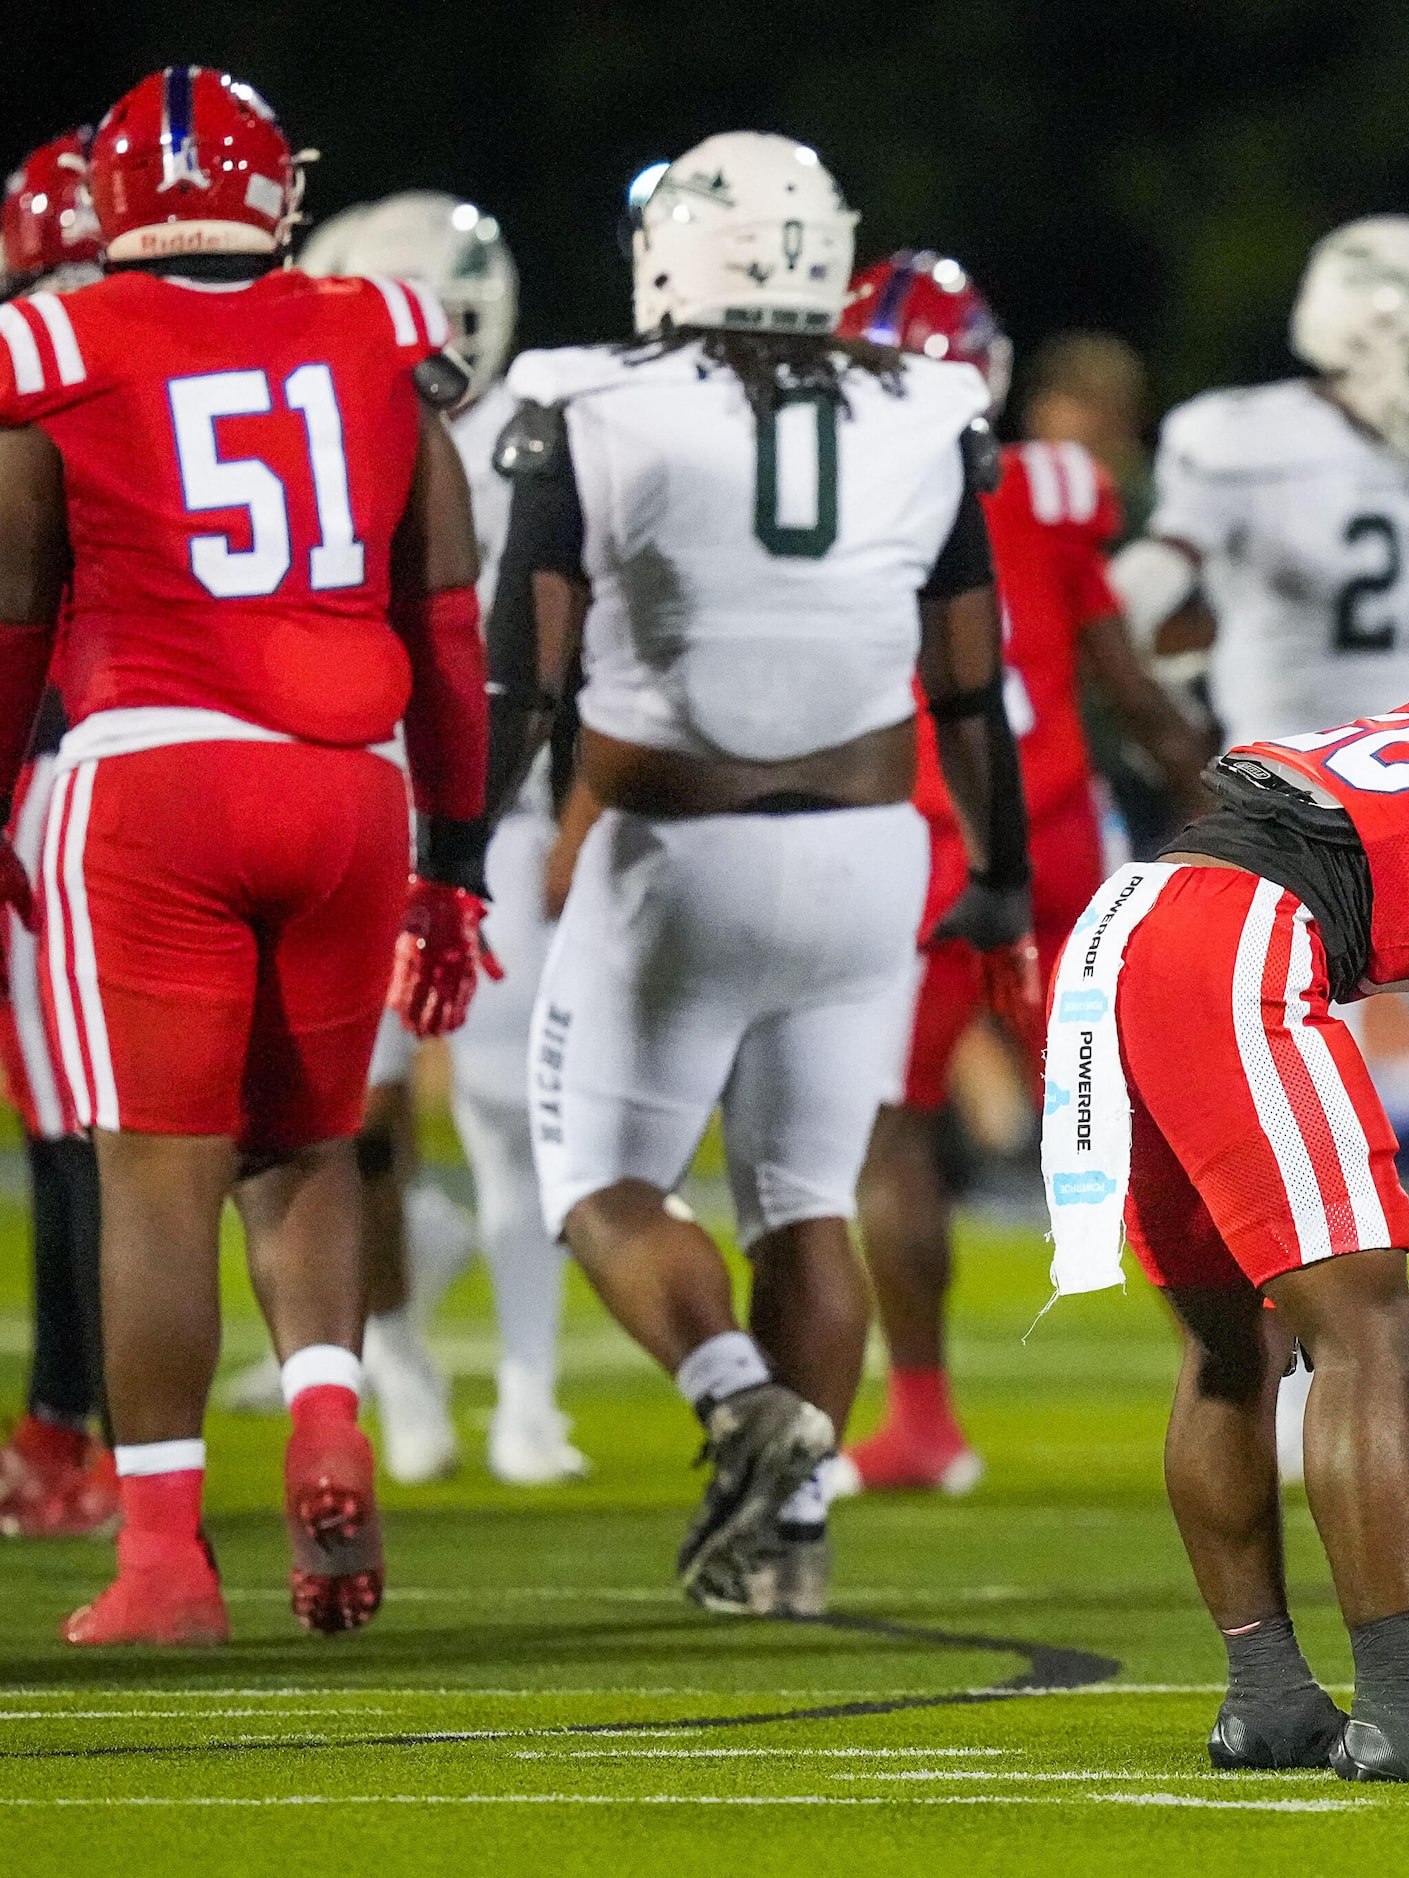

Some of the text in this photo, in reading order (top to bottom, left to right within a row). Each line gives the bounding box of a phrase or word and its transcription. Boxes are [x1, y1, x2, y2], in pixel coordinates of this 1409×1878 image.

[141, 231, 238, 250] Ridde
[166, 362, 366, 600] 51
[755, 386, 838, 559] 0
[1083, 875, 1144, 978] POWERADE
[1077, 1031, 1093, 1151] POWERADE
